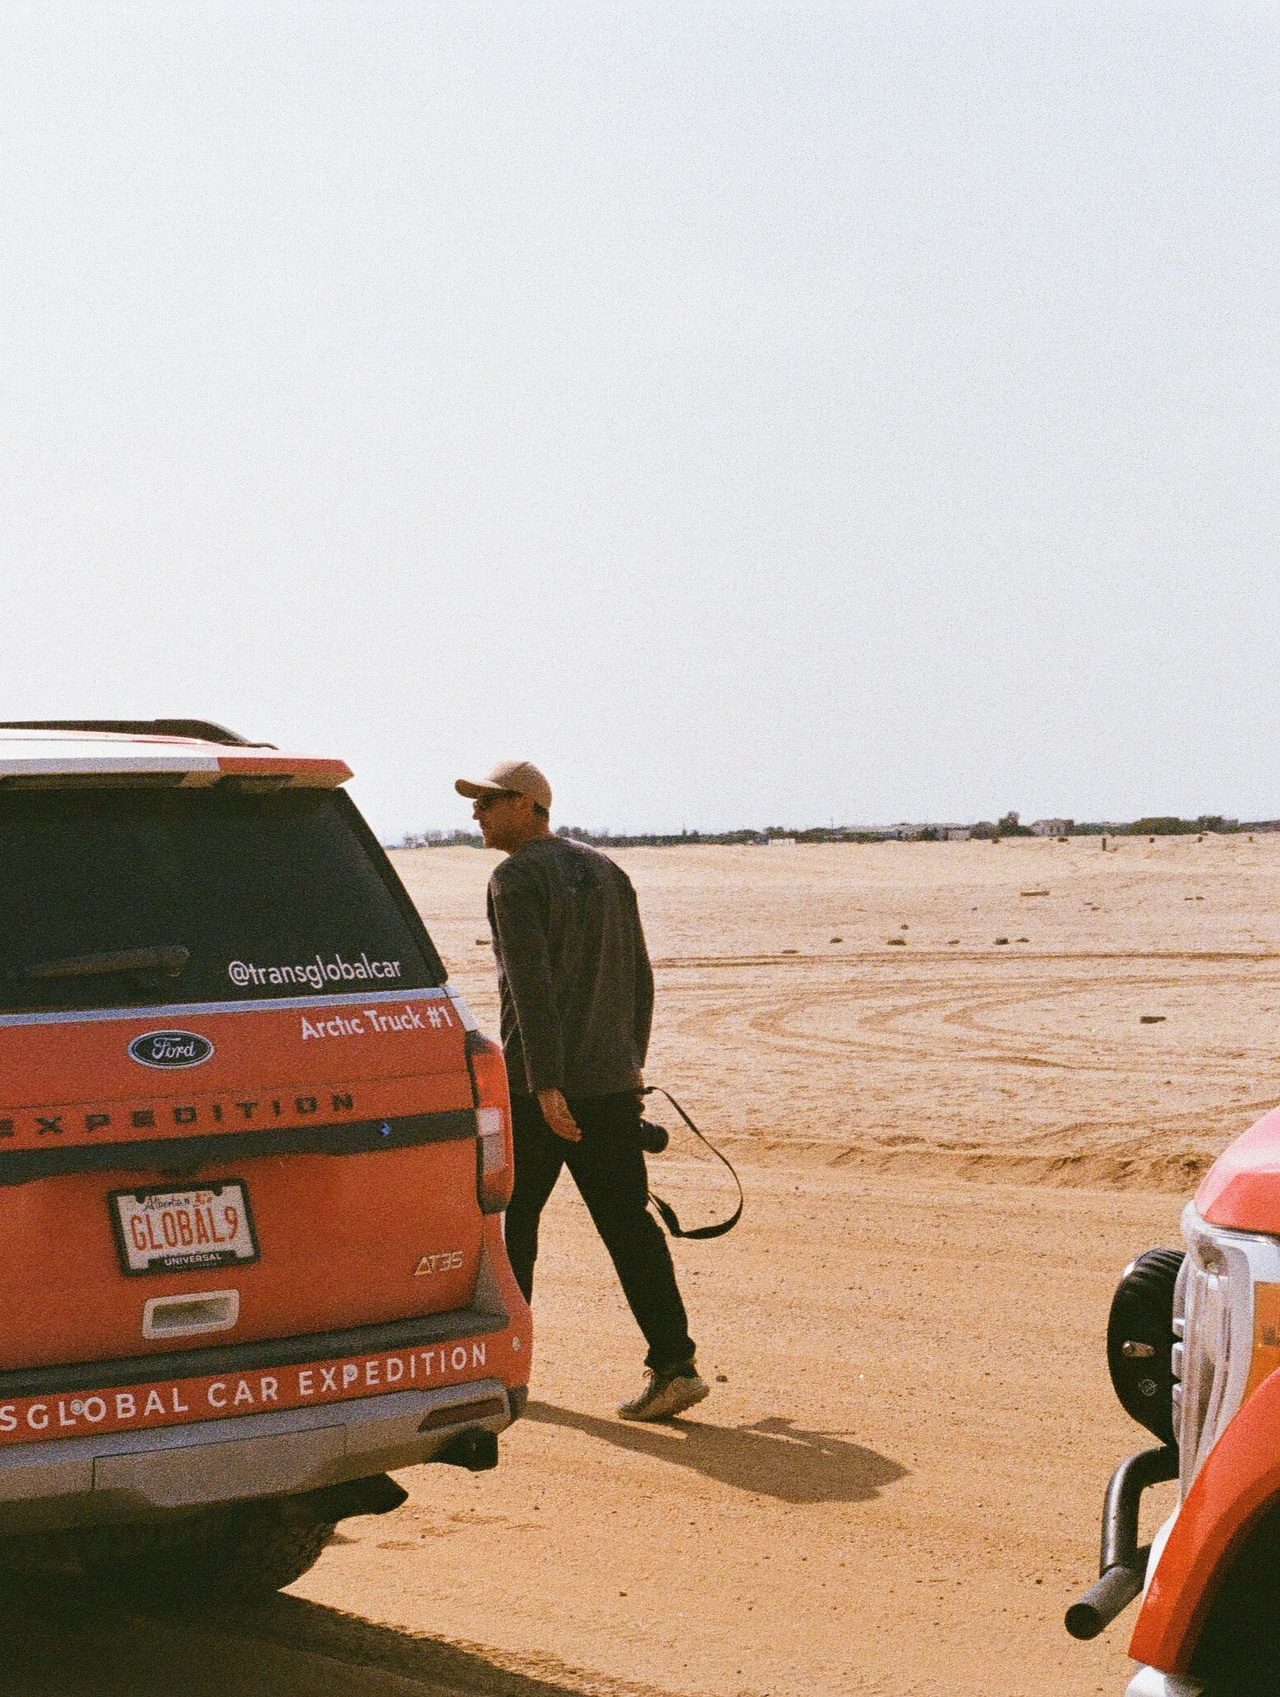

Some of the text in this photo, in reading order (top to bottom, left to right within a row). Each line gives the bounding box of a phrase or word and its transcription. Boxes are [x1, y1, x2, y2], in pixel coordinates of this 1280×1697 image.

[228, 953, 402, 989] @transglobalcar
[301, 1005, 454, 1040] Arctic Truck #1
[164, 1253, 222, 1266] UNIVERSAL
[207, 1377, 279, 1408] CAR
[298, 1342, 487, 1396] EXPEDITION
